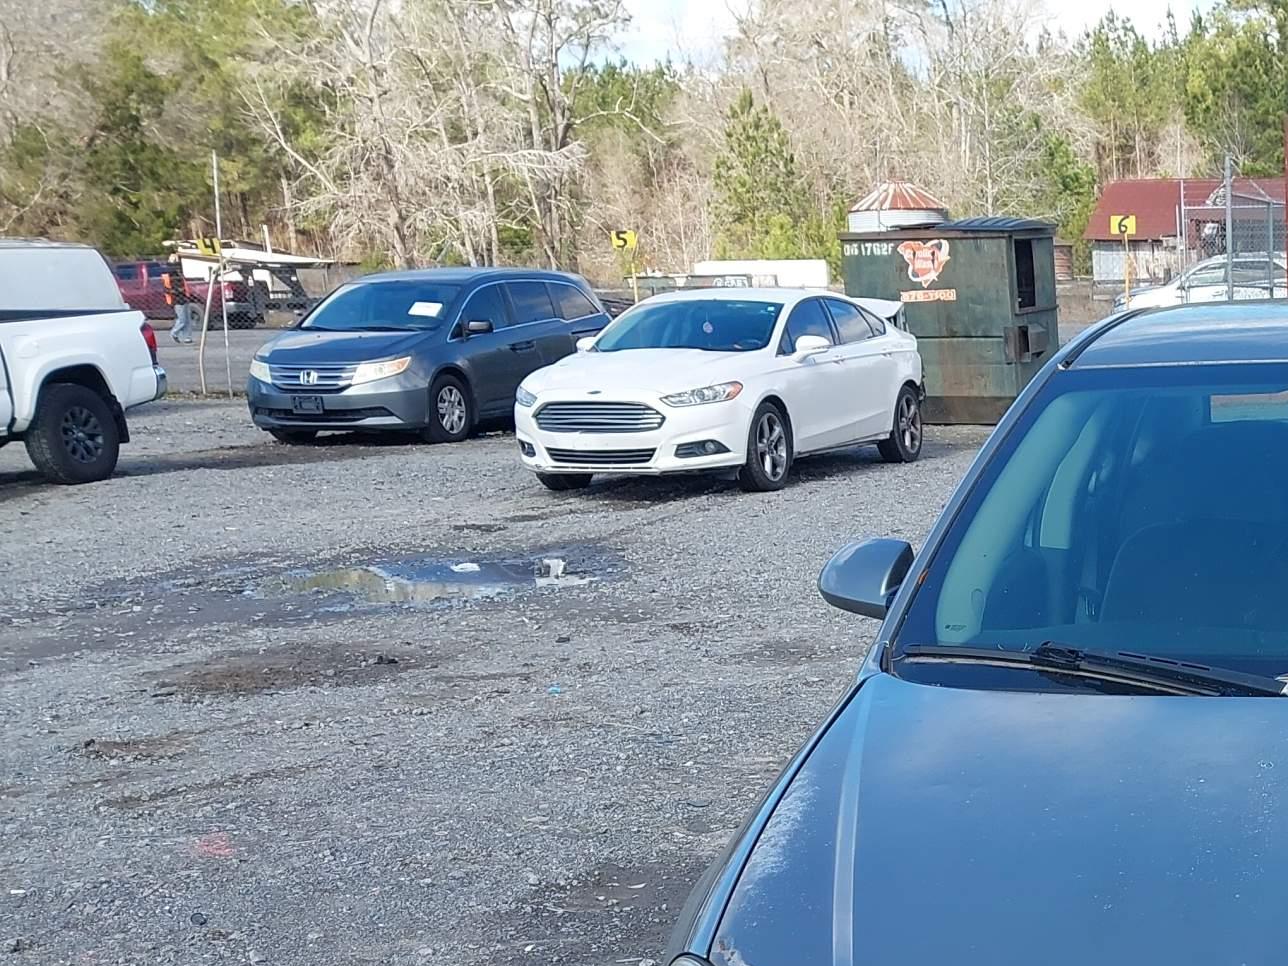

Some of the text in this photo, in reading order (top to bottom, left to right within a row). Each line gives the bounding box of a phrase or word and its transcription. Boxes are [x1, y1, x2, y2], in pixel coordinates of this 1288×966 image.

[1118, 215, 1130, 233] 6
[202, 237, 217, 254] 4
[615, 230, 628, 248] 5
